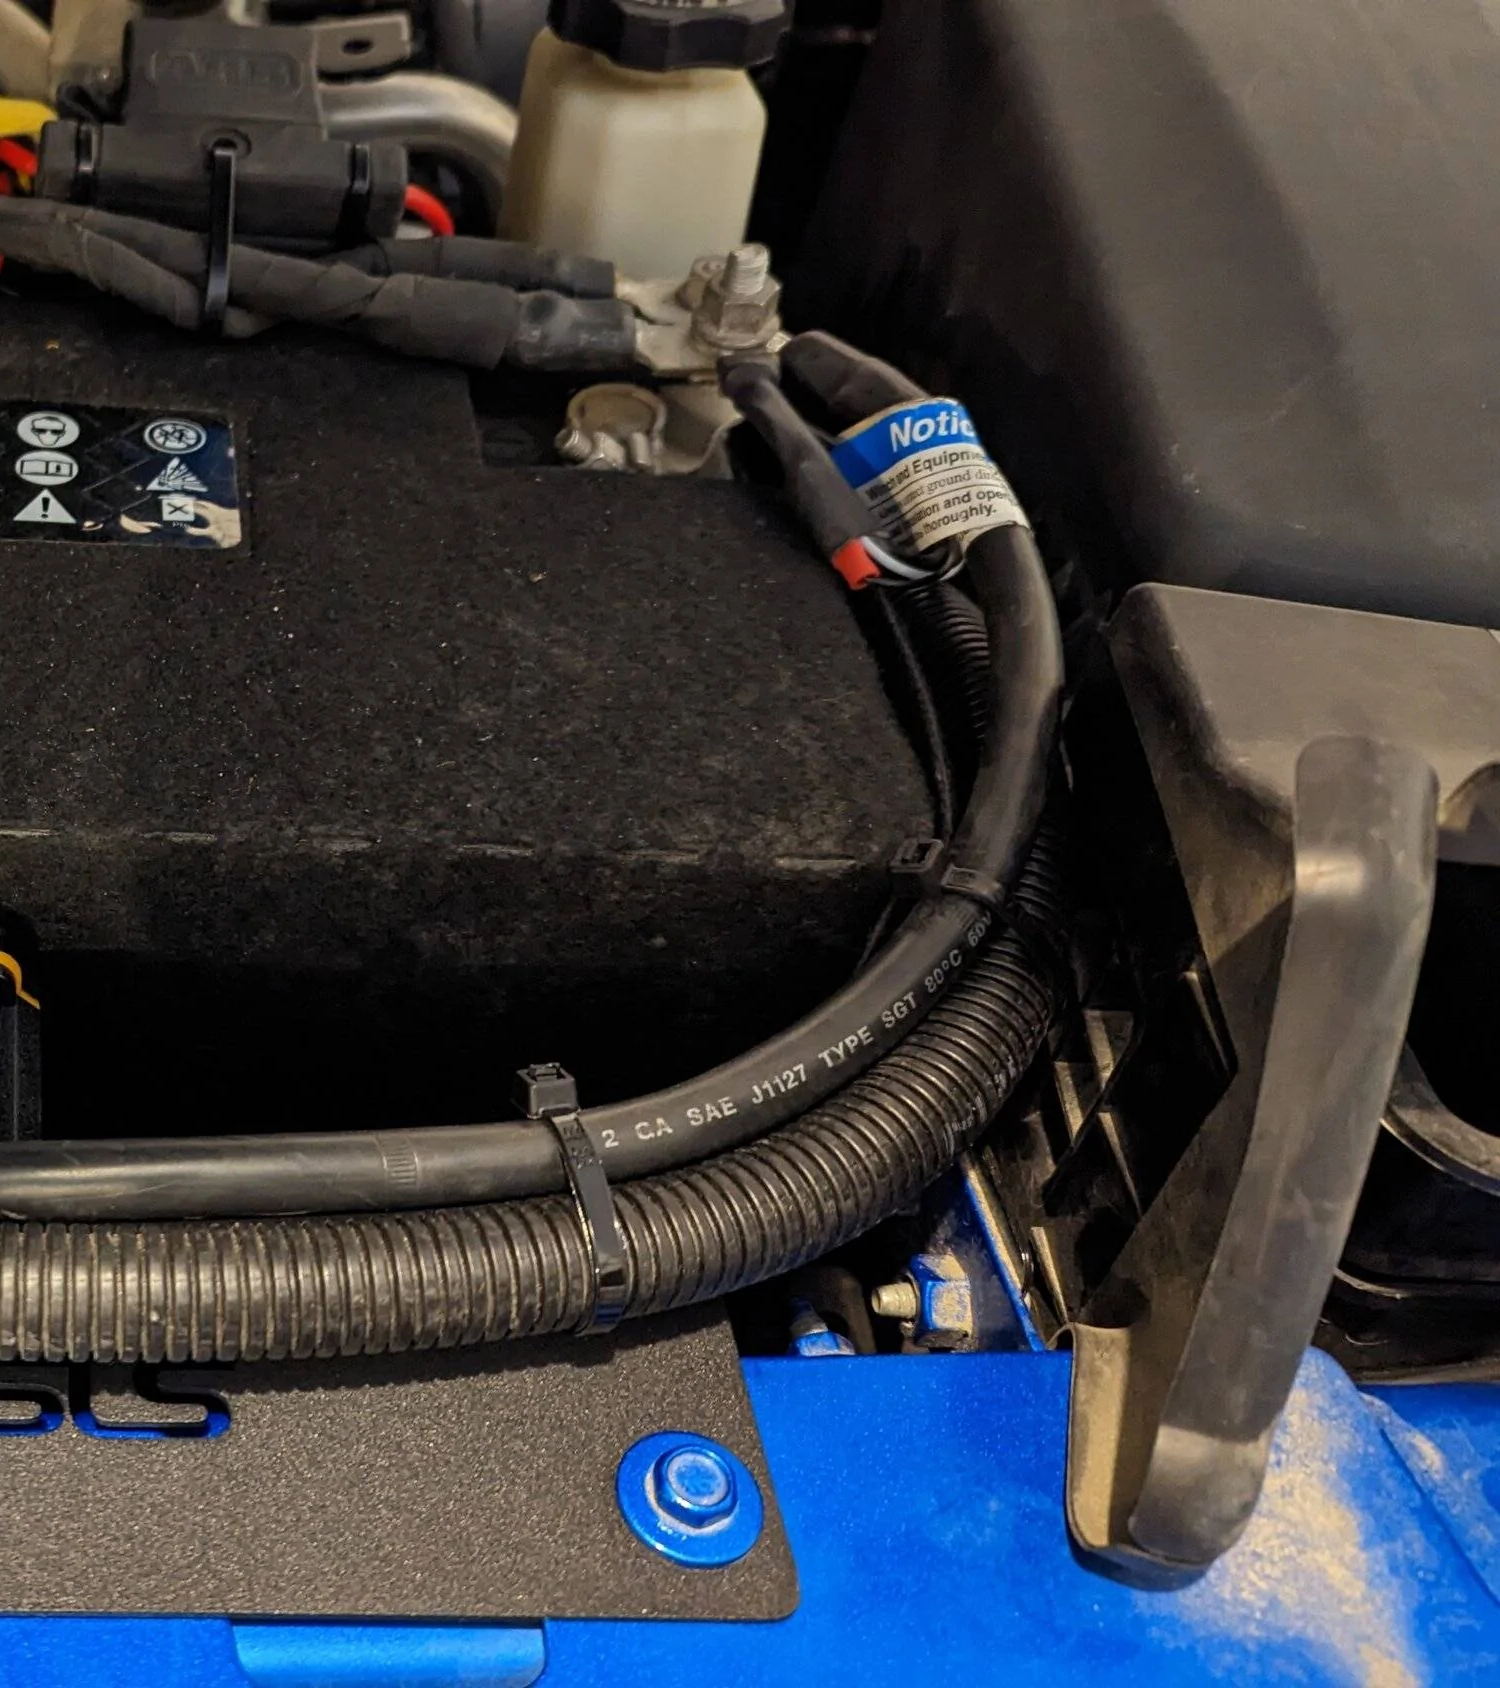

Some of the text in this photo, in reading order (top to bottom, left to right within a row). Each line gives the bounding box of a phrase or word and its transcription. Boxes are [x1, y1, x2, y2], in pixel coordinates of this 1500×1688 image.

[890, 410, 976, 453] Notic
[912, 450, 986, 475] Equipme
[926, 469, 971, 495] ground
[943, 490, 972, 510] and
[601, 1128, 620, 1149] 2
[686, 1096, 738, 1129] SAE
[751, 1063, 809, 1105] J1127
[818, 1025, 875, 1069] TYPE
[881, 992, 919, 1030] SGT
